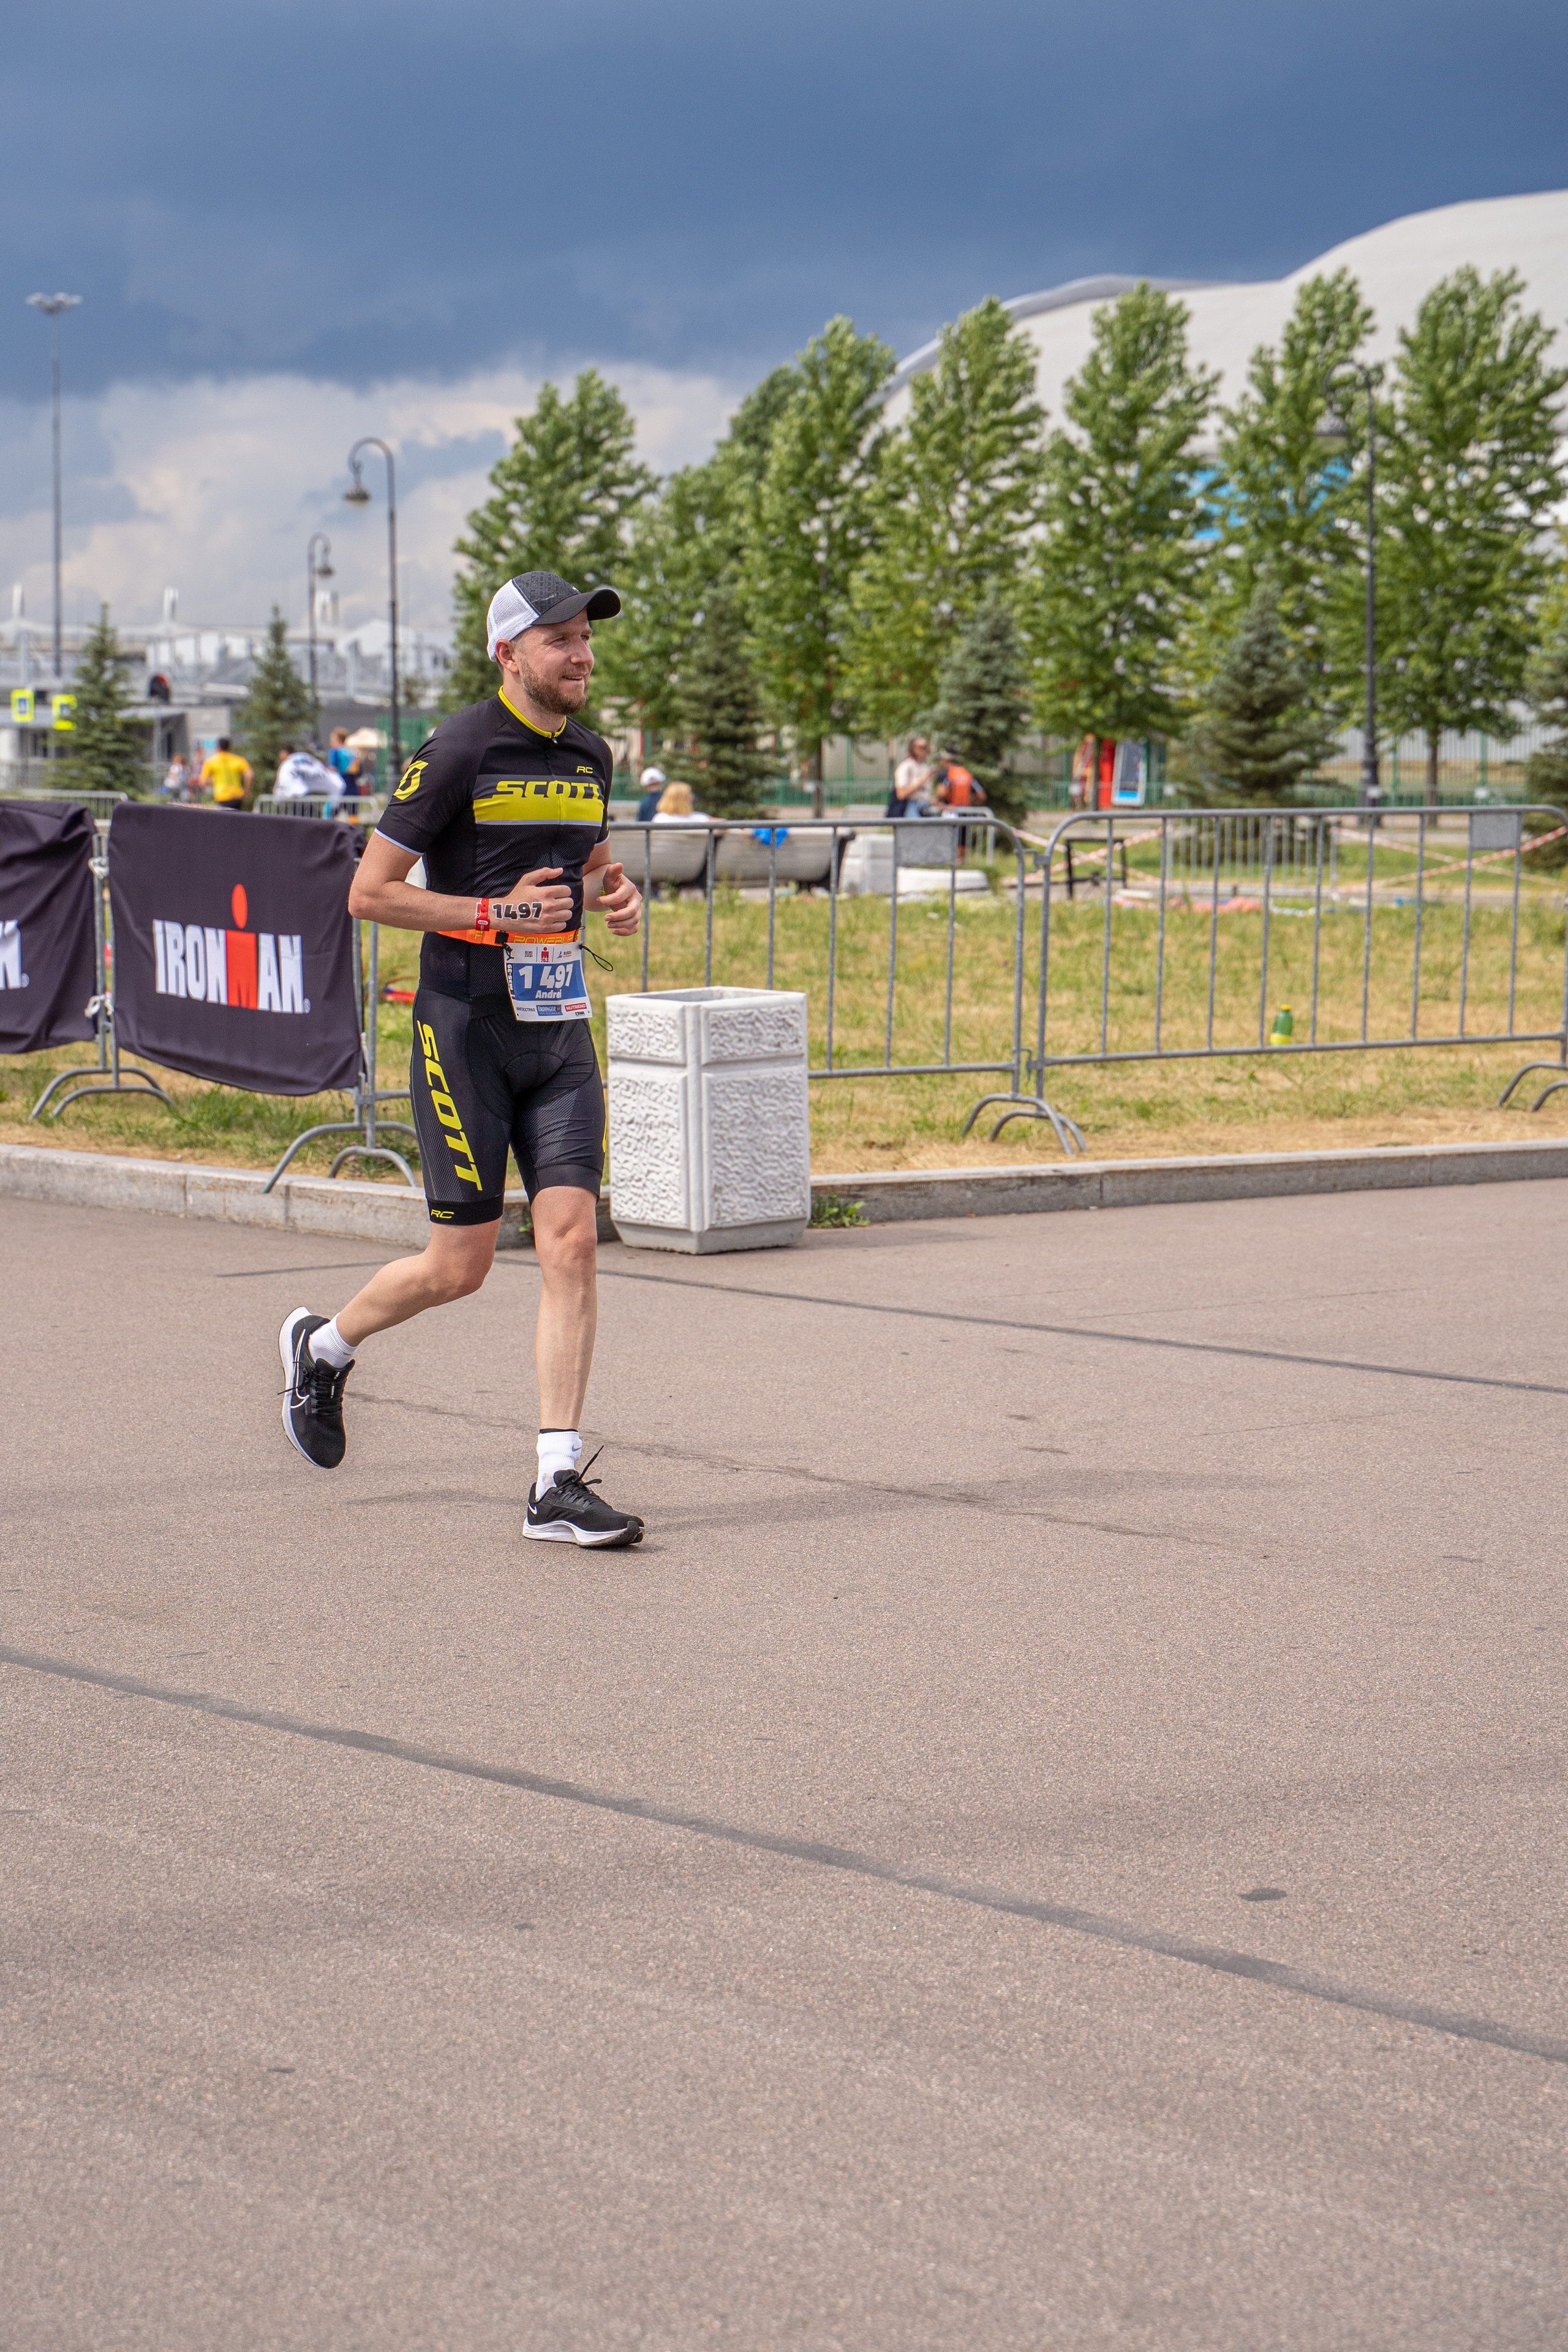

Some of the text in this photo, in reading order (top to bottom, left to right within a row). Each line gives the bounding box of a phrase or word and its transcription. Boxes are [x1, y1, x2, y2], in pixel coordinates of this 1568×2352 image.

[494, 780, 600, 799] SCOTT
[492, 902, 543, 920] 1497
[153, 919, 304, 1014] IRONMAN
[535, 989, 562, 999] Andrei
[417, 1020, 483, 1191] SCOTT
[431, 1209, 454, 1219] RC
